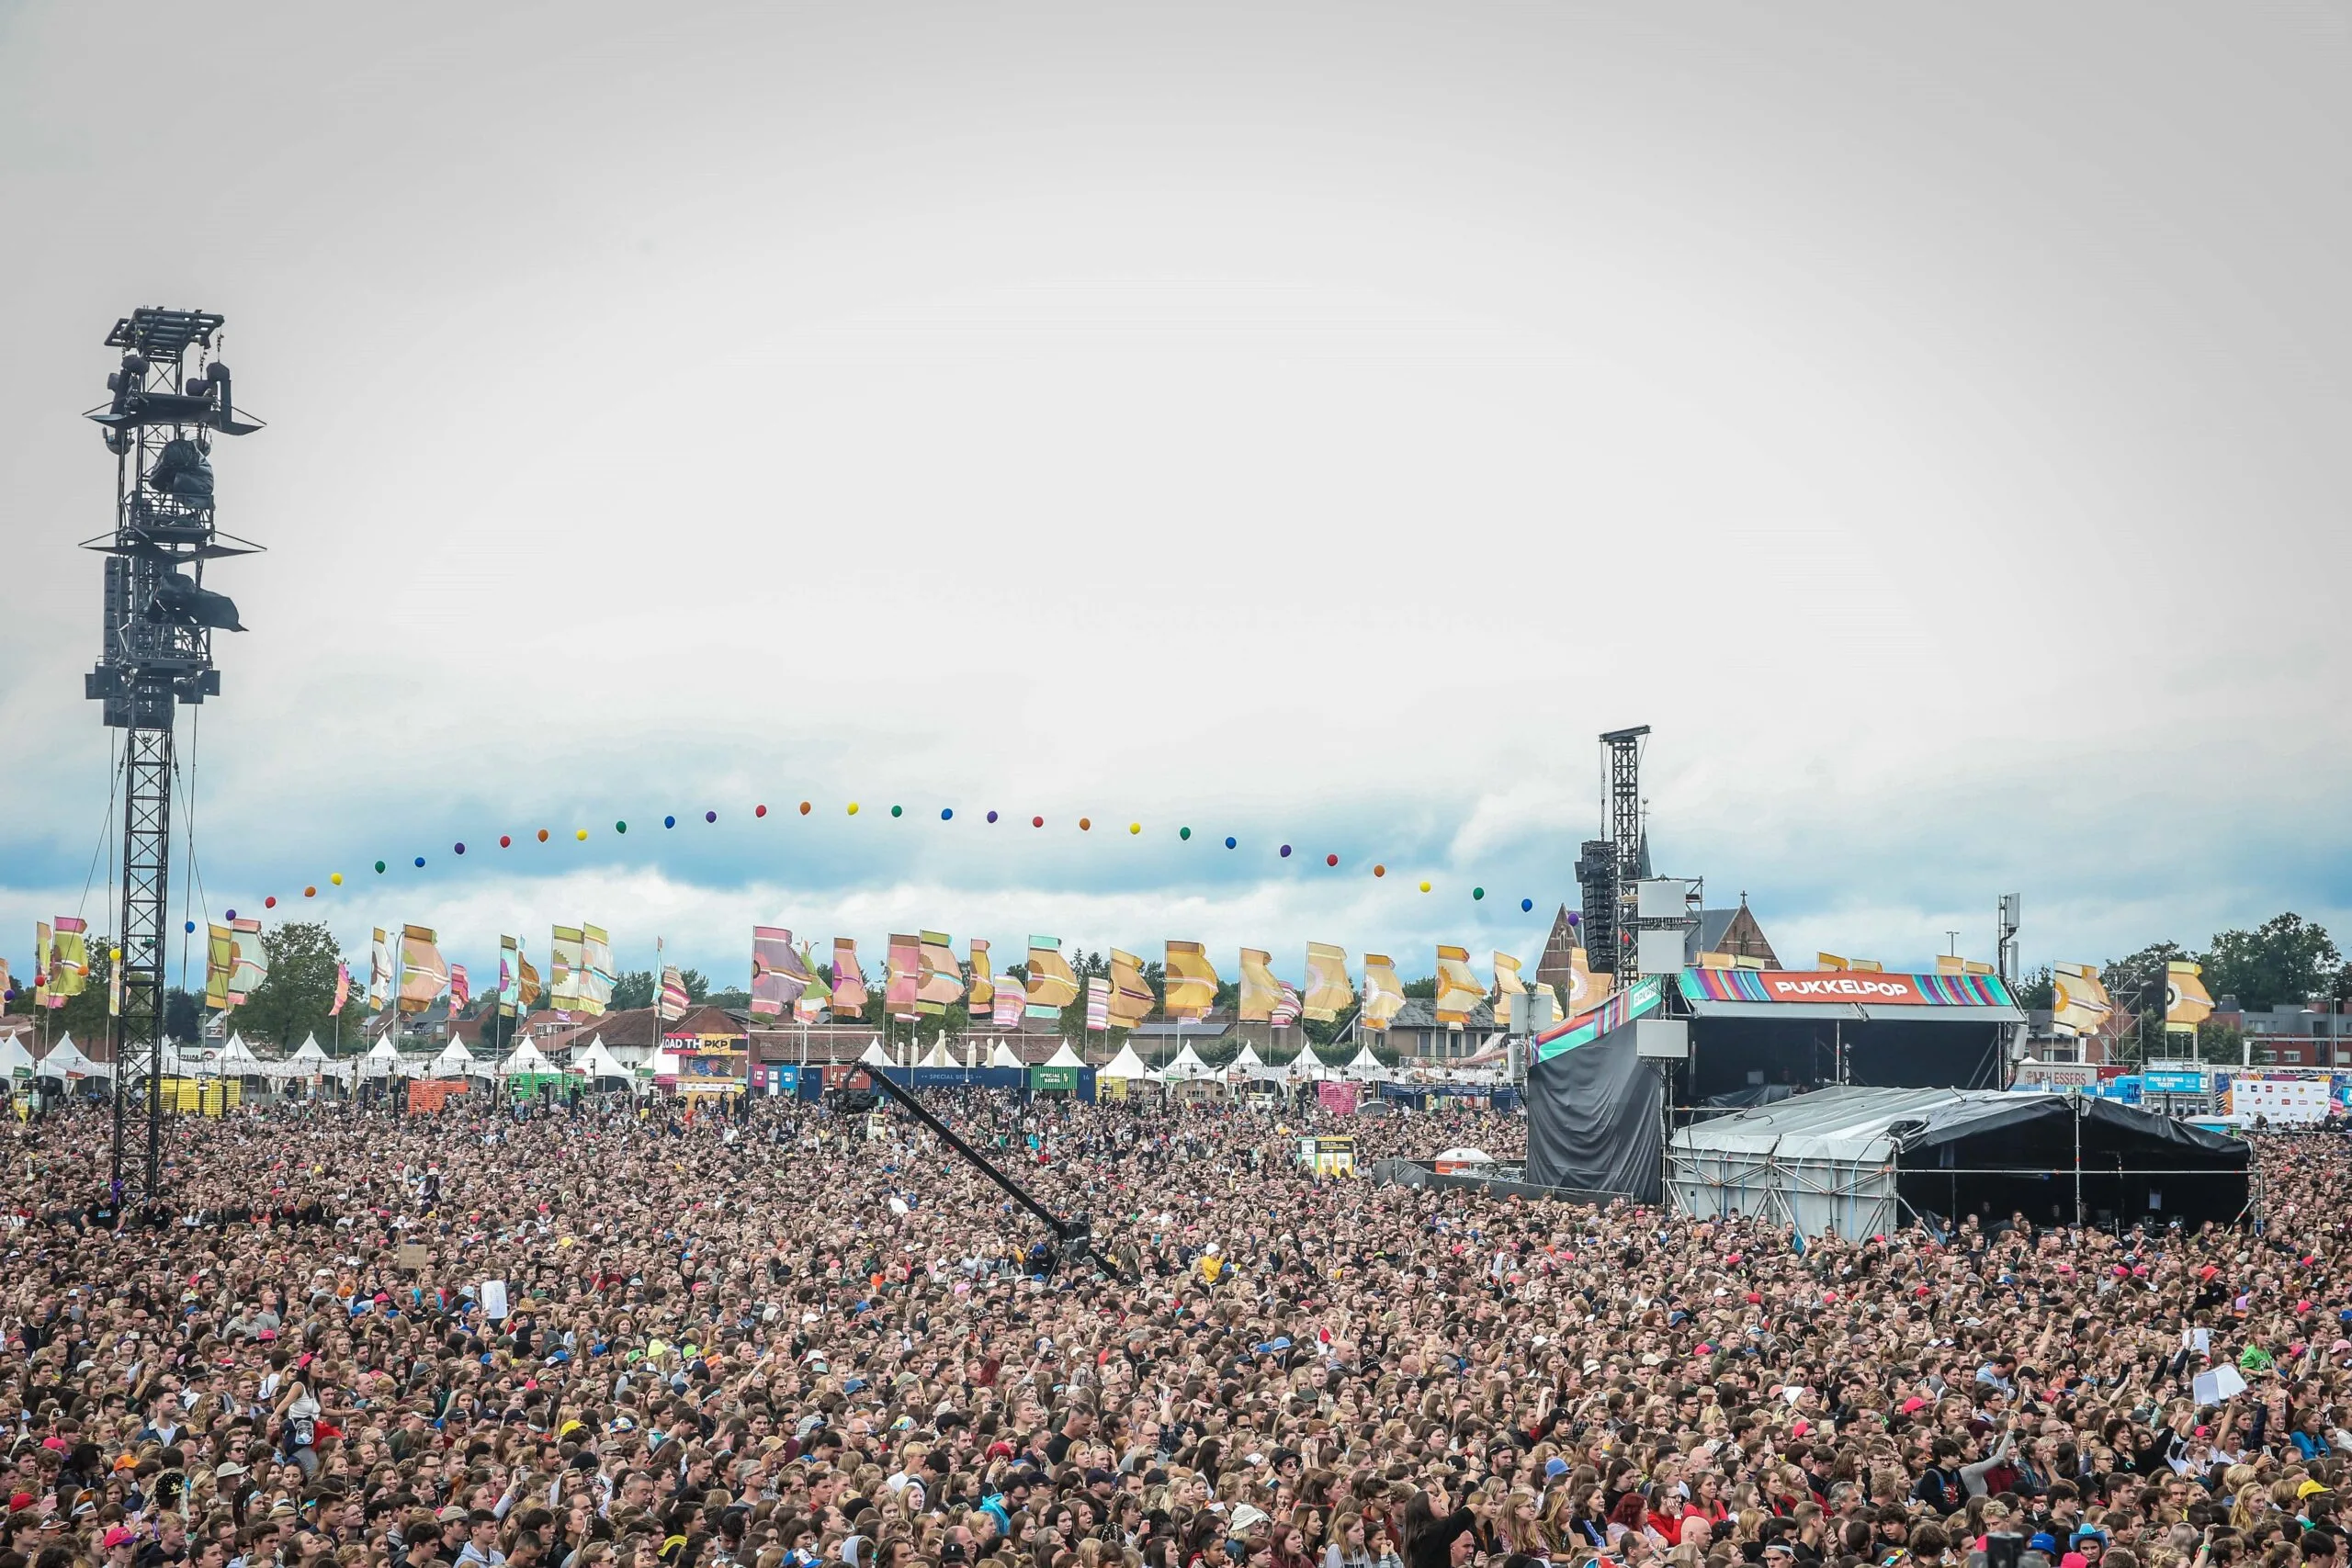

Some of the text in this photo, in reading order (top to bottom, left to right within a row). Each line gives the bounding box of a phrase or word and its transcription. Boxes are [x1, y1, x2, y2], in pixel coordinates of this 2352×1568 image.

[1774, 978, 1908, 997] PUKKELPOP
[704, 1040, 728, 1049] PKP
[2054, 1072, 2086, 1086] ESSERS
